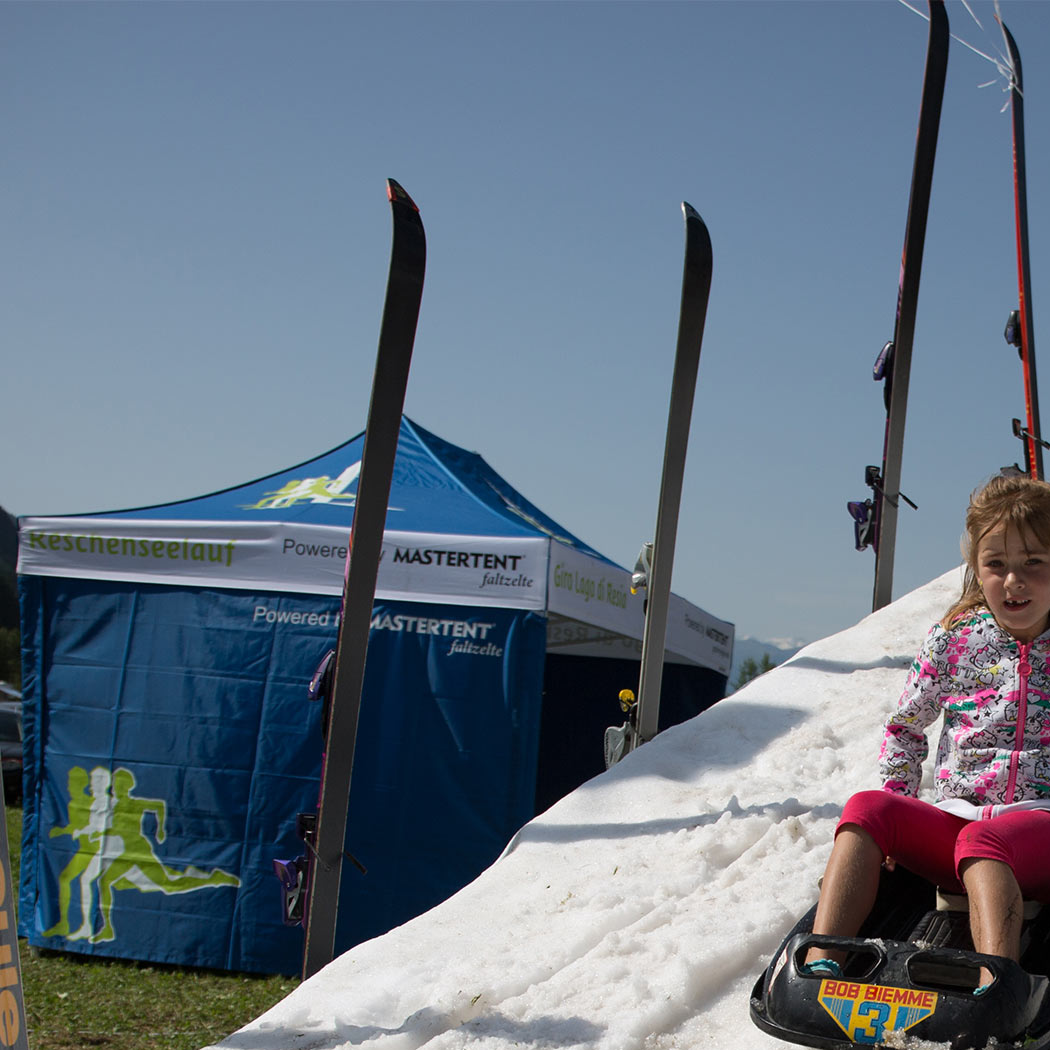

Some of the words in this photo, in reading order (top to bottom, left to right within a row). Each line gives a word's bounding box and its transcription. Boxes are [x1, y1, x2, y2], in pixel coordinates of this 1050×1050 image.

[29, 533, 236, 566] Reschenseelauf
[283, 538, 347, 559] Powere
[393, 548, 522, 571] MASTERTENT
[479, 573, 533, 588] faltzelte
[554, 562, 573, 591] Giro
[575, 570, 595, 602] Lago
[253, 606, 329, 627] Powered
[447, 640, 502, 656] faltzelte
[823, 981, 860, 999] BOB
[864, 986, 934, 1008] BIEMME
[853, 1001, 891, 1044] 3
